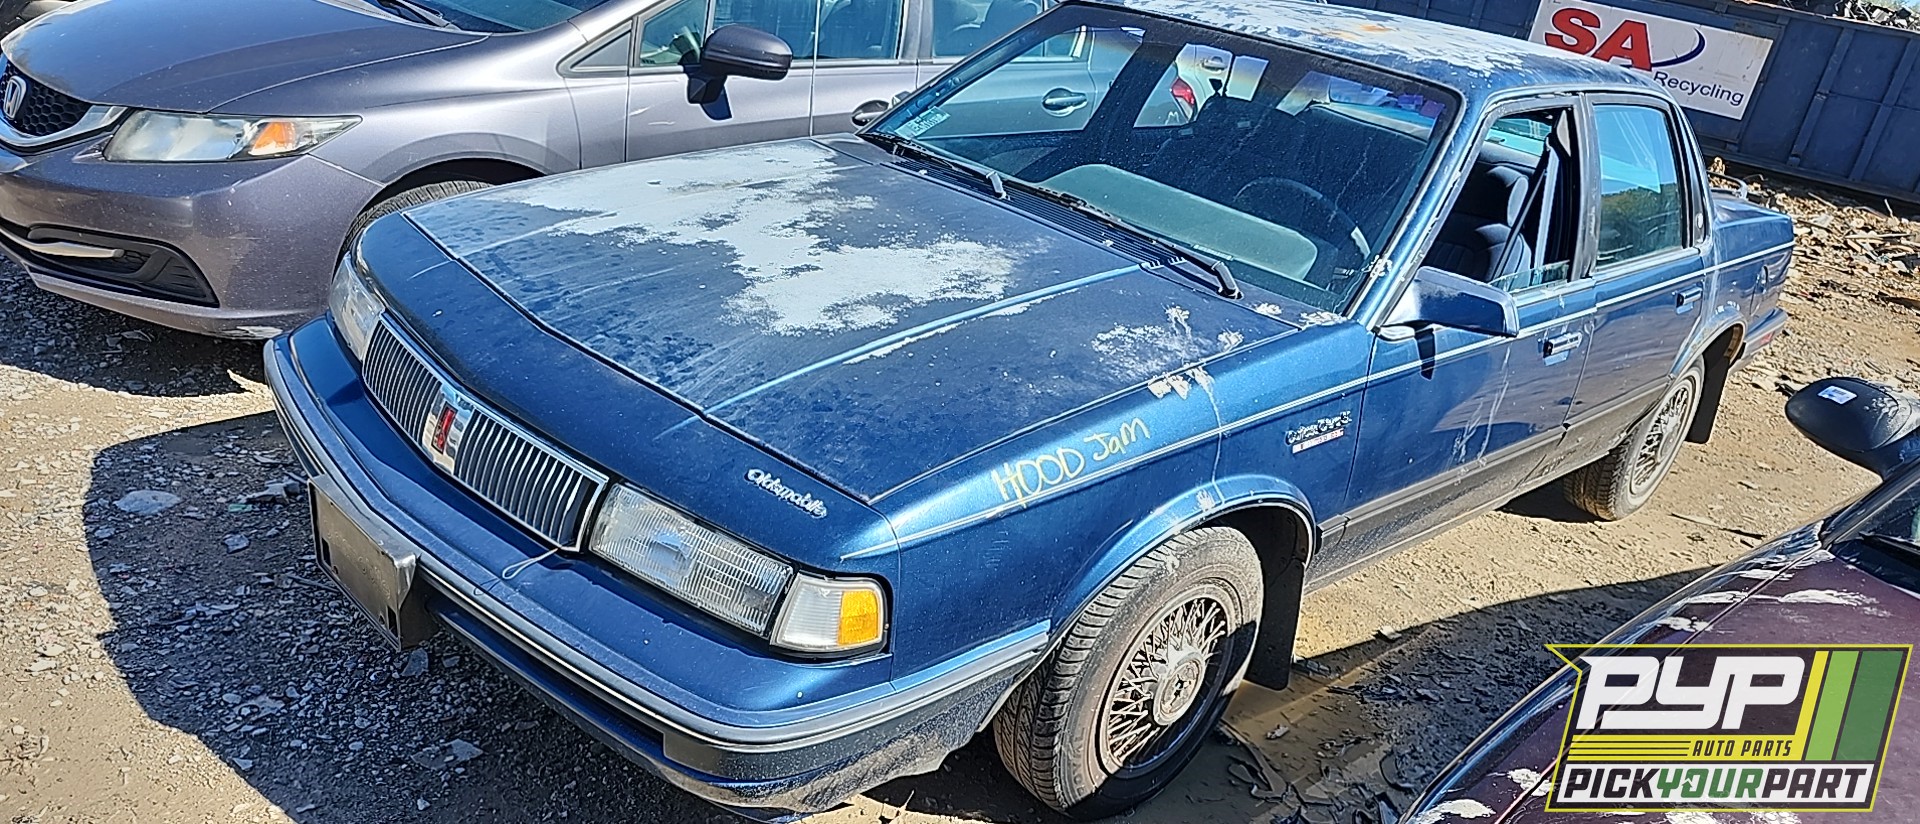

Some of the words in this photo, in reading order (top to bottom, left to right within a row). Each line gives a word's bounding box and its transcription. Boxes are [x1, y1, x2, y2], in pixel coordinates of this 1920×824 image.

[1544, 7, 1653, 71] SA
[1653, 71, 1745, 106] Recycling
[747, 469, 827, 518] Oldsmobile
[990, 448, 1085, 508] HOOD
